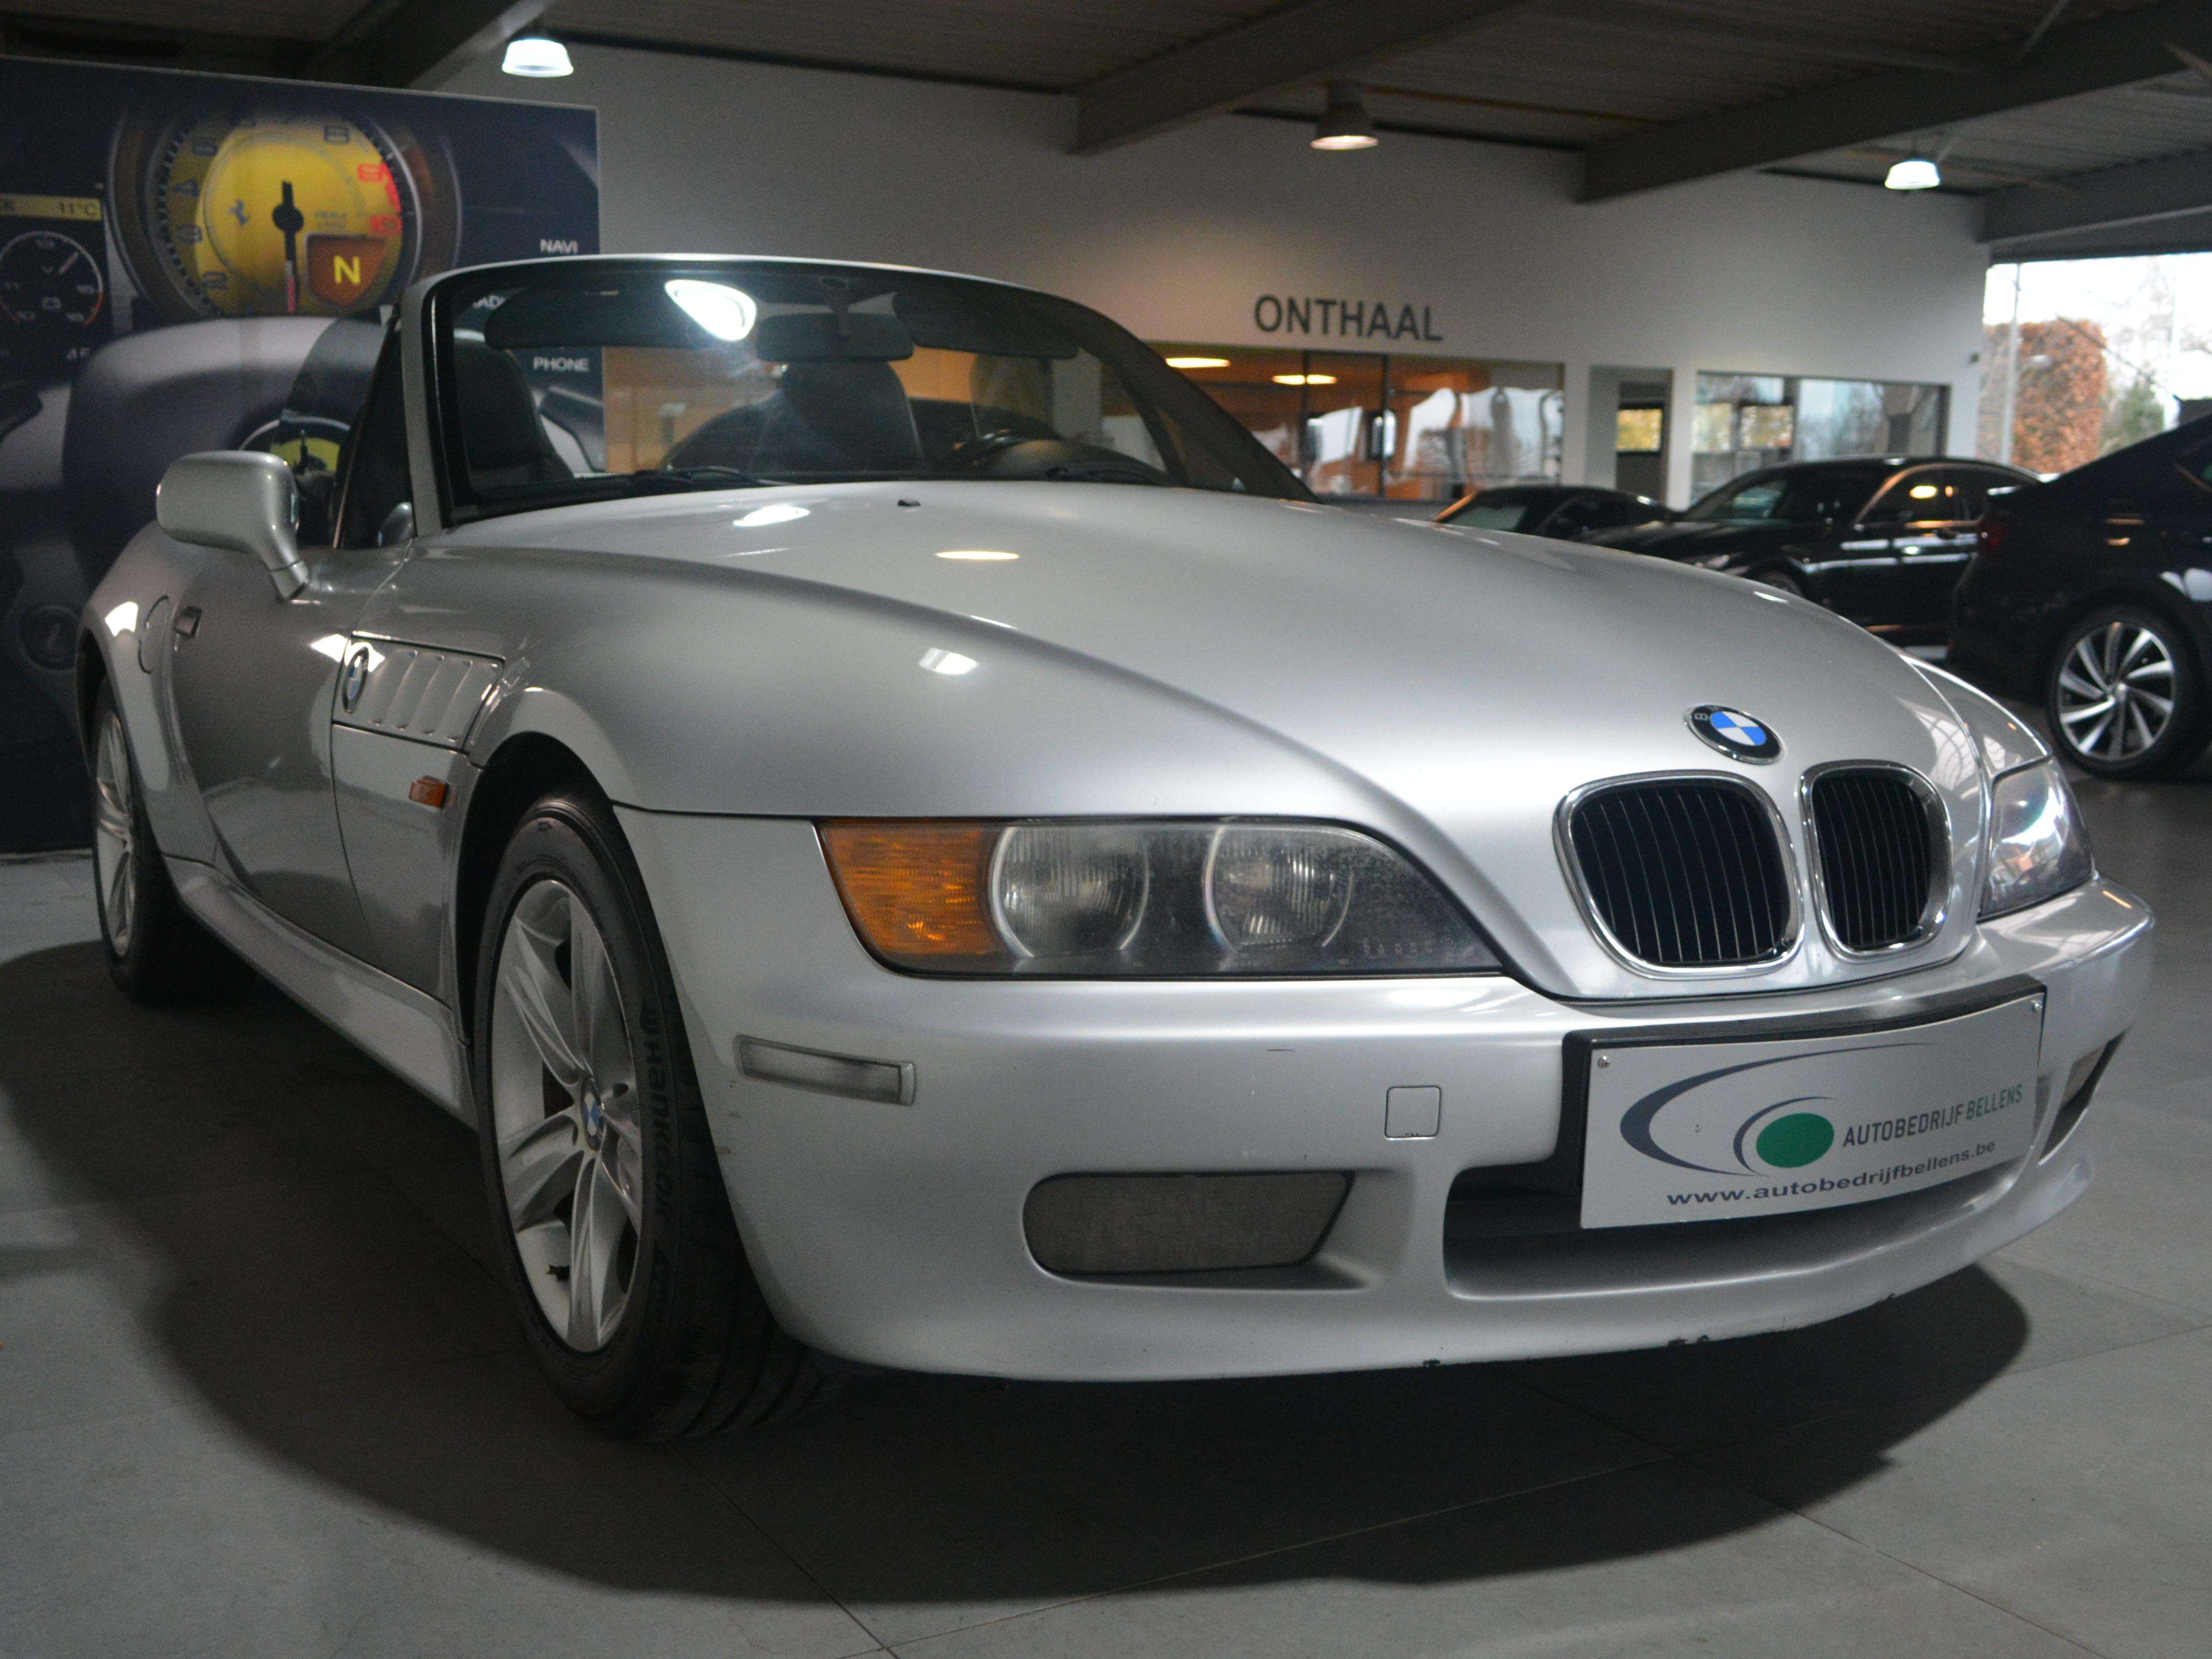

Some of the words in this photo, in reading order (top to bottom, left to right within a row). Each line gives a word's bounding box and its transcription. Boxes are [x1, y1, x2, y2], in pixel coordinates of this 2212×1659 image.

[540, 239, 578, 254] NAVI
[333, 256, 361, 285] N
[1254, 294, 1443, 341] ONTHAAL
[533, 357, 590, 373] PHONE
[1843, 1103, 1964, 1147] AUTOBEDRIJF
[1966, 1084, 2023, 1120] BELLENS
[1666, 1140, 1996, 1205] www.autobedrijfbellens.be
